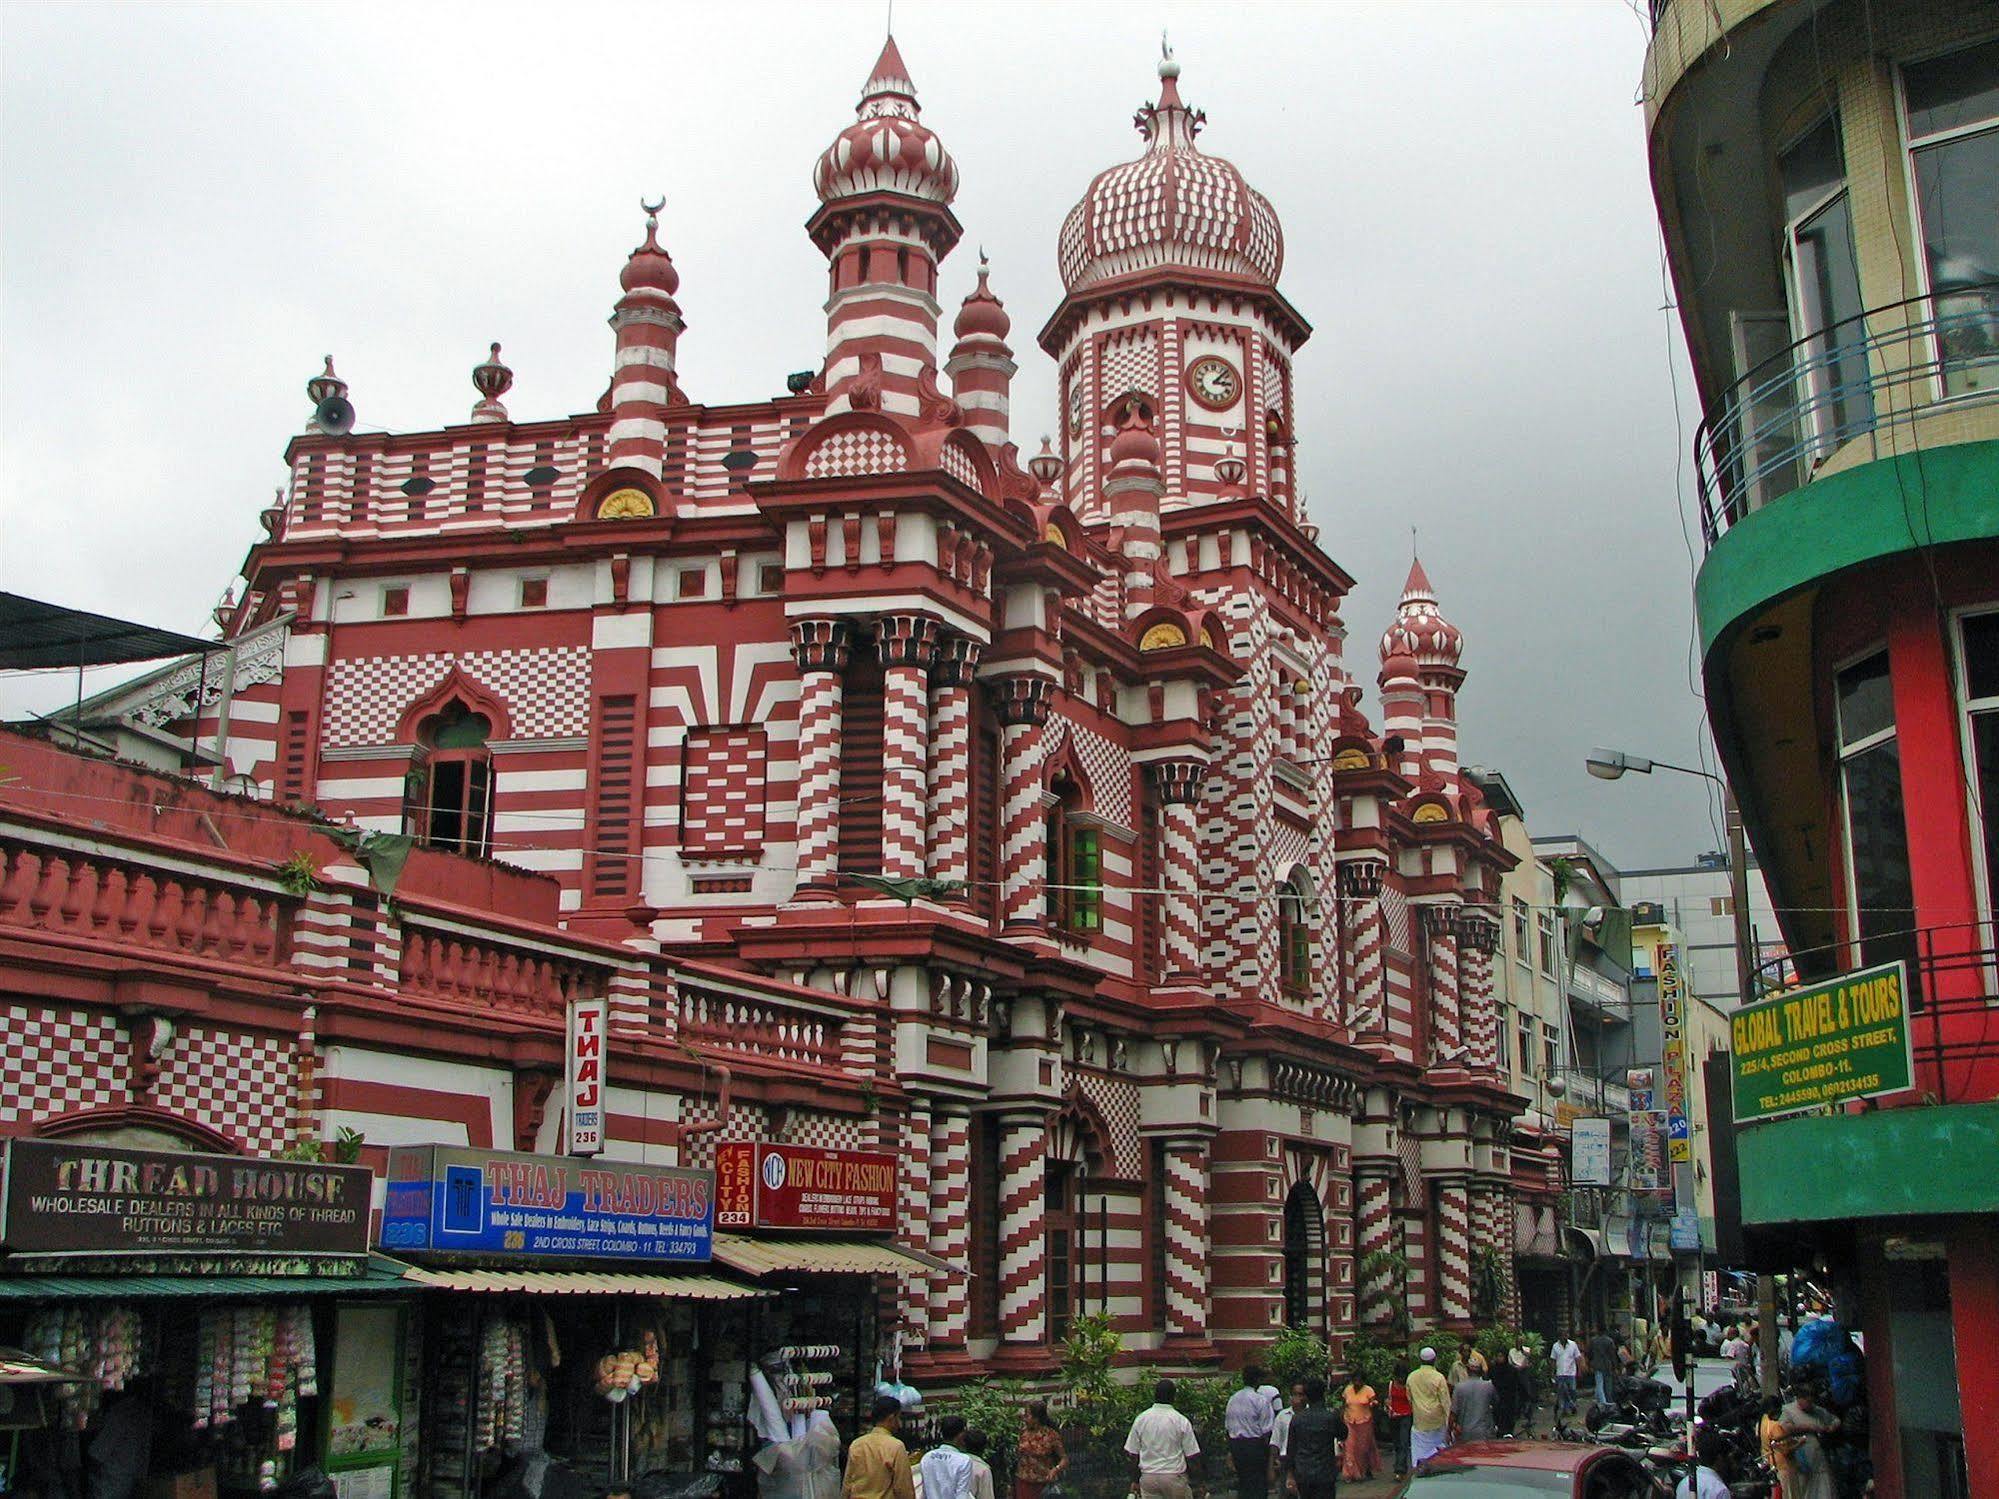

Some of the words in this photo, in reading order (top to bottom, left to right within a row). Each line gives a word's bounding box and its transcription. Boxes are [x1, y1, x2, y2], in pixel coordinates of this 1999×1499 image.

[1661, 949, 1680, 1040] FASHION
[1733, 1007, 1783, 1056] GLOBAL
[1783, 993, 1836, 1043] TRAVEL
[1838, 987, 1849, 1030] &
[1849, 974, 1900, 1027] TOURS
[576, 1010, 600, 1107] THAJ
[1770, 1047, 1811, 1068] SECOND
[1812, 1038, 1850, 1058] CROSS
[1667, 1051, 1684, 1117] PLAZA
[576, 1131, 597, 1143] 236
[53, 1158, 219, 1196] THREAD
[231, 1168, 345, 1204] HOUSE
[487, 1160, 568, 1210] THAJ
[578, 1169, 708, 1220] TRADERS
[720, 1162, 734, 1212] CITY
[736, 1150, 751, 1212] FASHION
[787, 1157, 815, 1189] NEW
[816, 1160, 843, 1190] CITY
[844, 1162, 894, 1193] FASHION
[31, 1196, 124, 1215] WHOLESALE
[129, 1200, 195, 1217] DEALERS
[200, 1203, 214, 1217] IN
[217, 1203, 241, 1219] ALL
[247, 1205, 285, 1220] KINDS
[289, 1206, 306, 1221] OF
[310, 1207, 356, 1223] THREAD
[123, 1217, 192, 1233] BUTTONS
[196, 1220, 206, 1234] &
[211, 1220, 254, 1235] LACES
[721, 1212, 747, 1223] 234
[533, 1236, 551, 1248] 2ND
[551, 1237, 577, 1249] CROSS
[602, 1240, 638, 1252] COLOMBO
[669, 1241, 697, 1255] 334793
